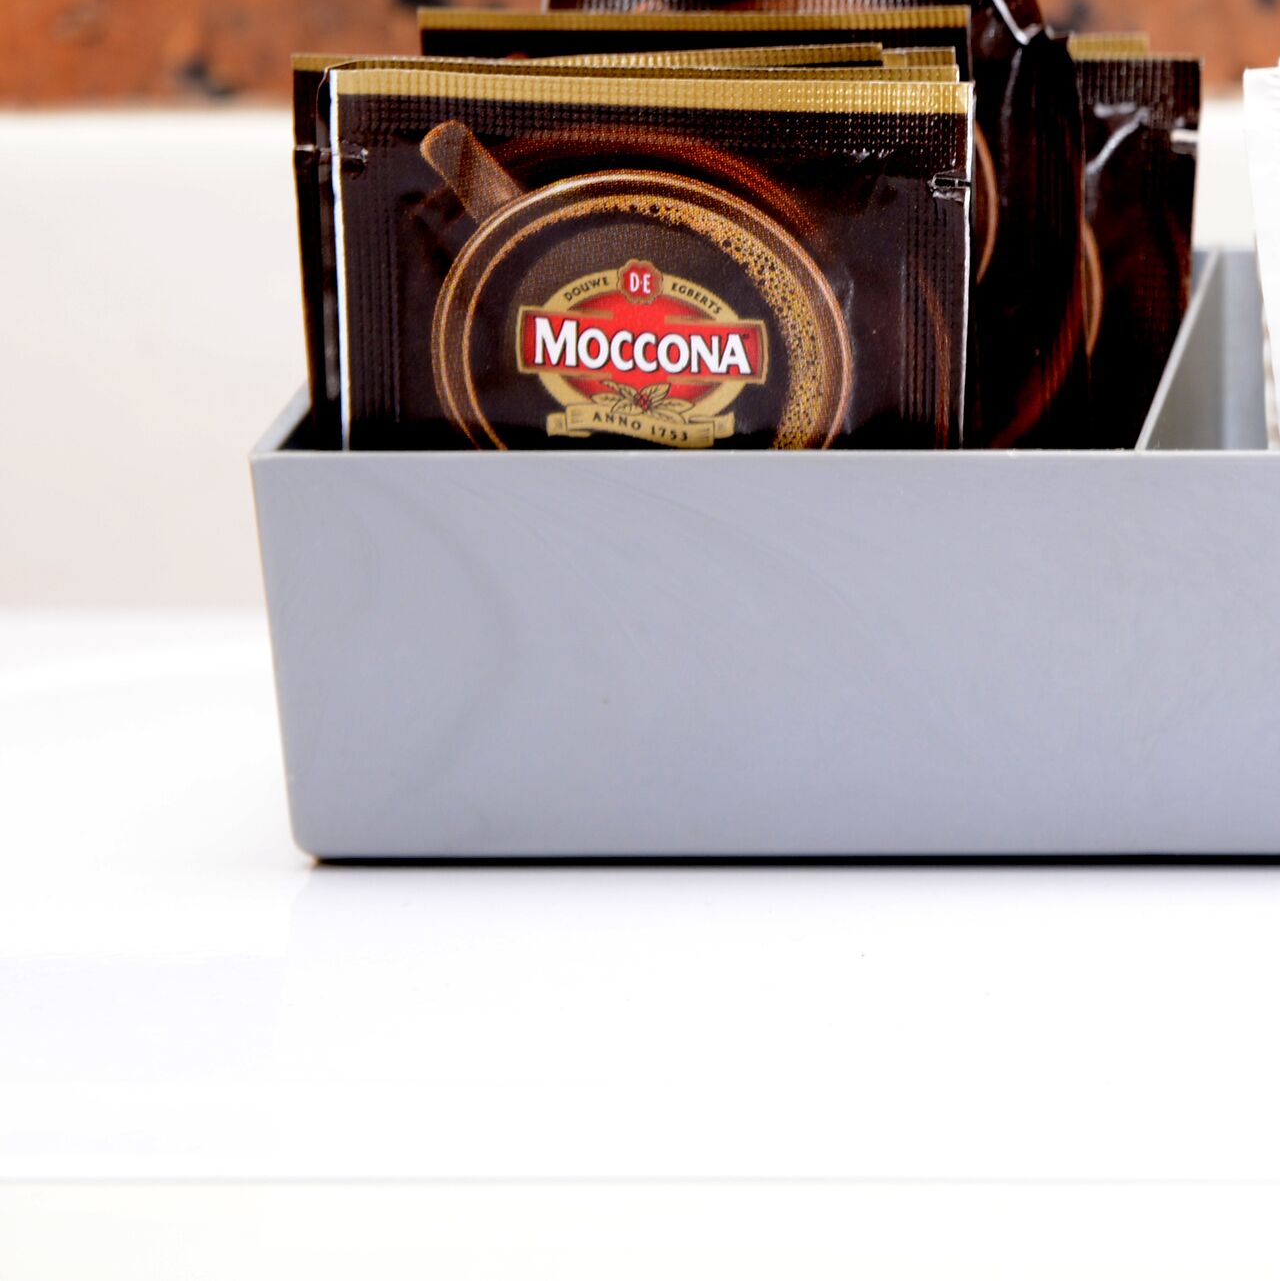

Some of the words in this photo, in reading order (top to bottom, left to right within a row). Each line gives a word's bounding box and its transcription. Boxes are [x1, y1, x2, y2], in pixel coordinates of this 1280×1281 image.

[563, 276, 610, 302] DOUWE
[671, 282, 723, 315] EGBERTS
[593, 412, 642, 431] ANNO
[651, 424, 689, 442] 1753
